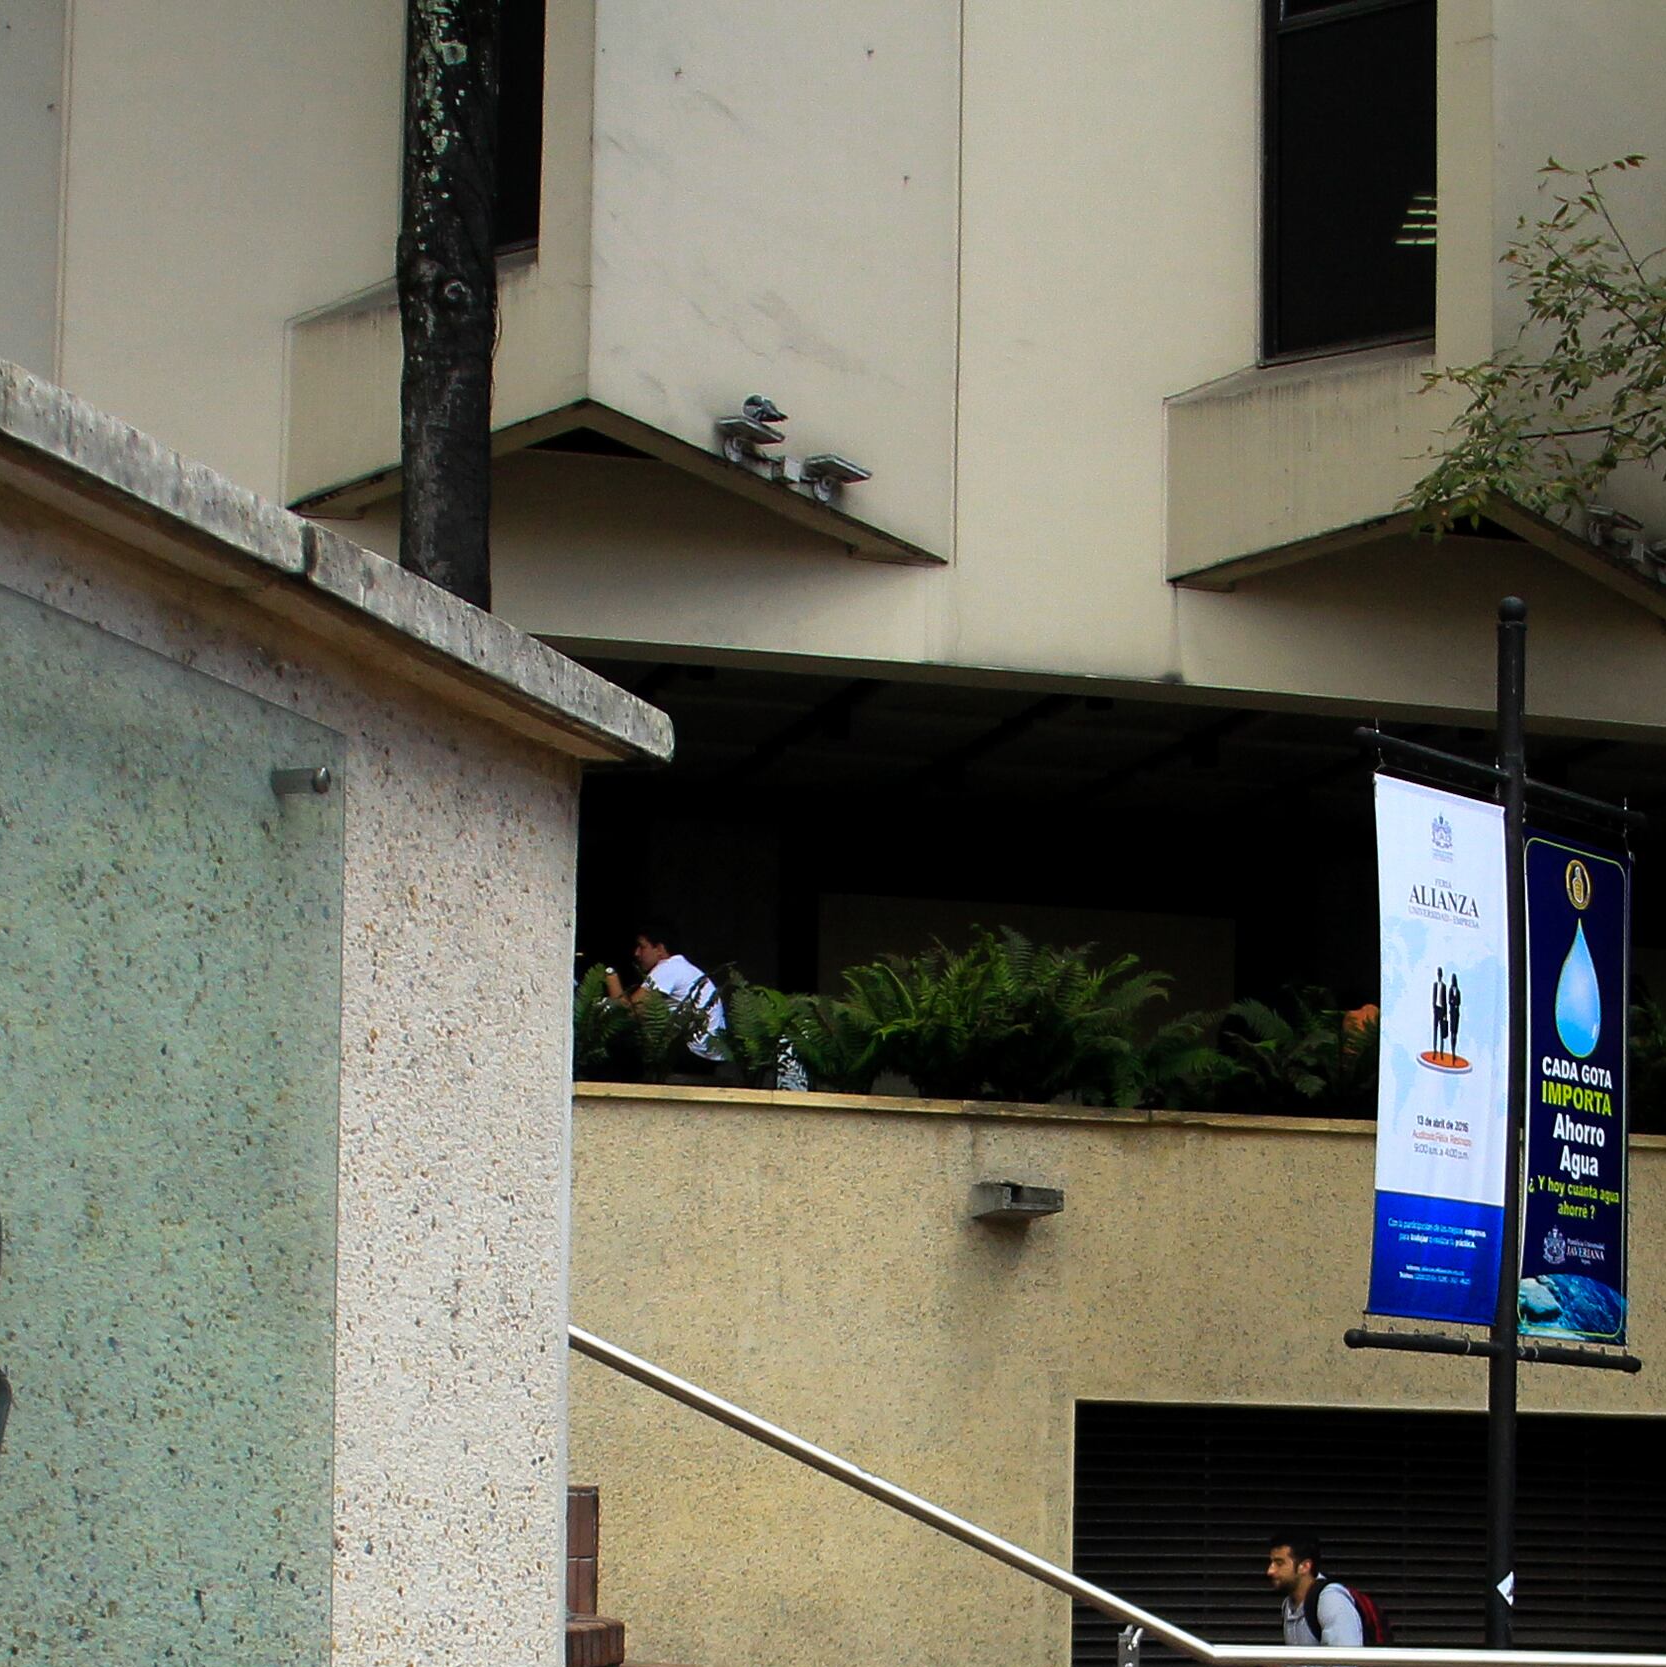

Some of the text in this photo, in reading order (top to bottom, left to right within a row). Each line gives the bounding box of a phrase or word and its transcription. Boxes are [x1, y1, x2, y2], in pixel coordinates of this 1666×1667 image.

[1409, 884, 1480, 919] ALIANZA
[1542, 1056, 1613, 1090] CADA GOTA
[1541, 1080, 1613, 1117] IMPORTA
[1552, 1112, 1606, 1148] Ahorro
[1559, 1145, 1599, 1180] Agua
[1537, 1175, 1546, 1190] Y
[1547, 1177, 1566, 1197] hoy
[1567, 1182, 1598, 1199] cuánta
[1599, 1189, 1620, 1205] agua
[1566, 1246, 1605, 1261] JAVERIANA
